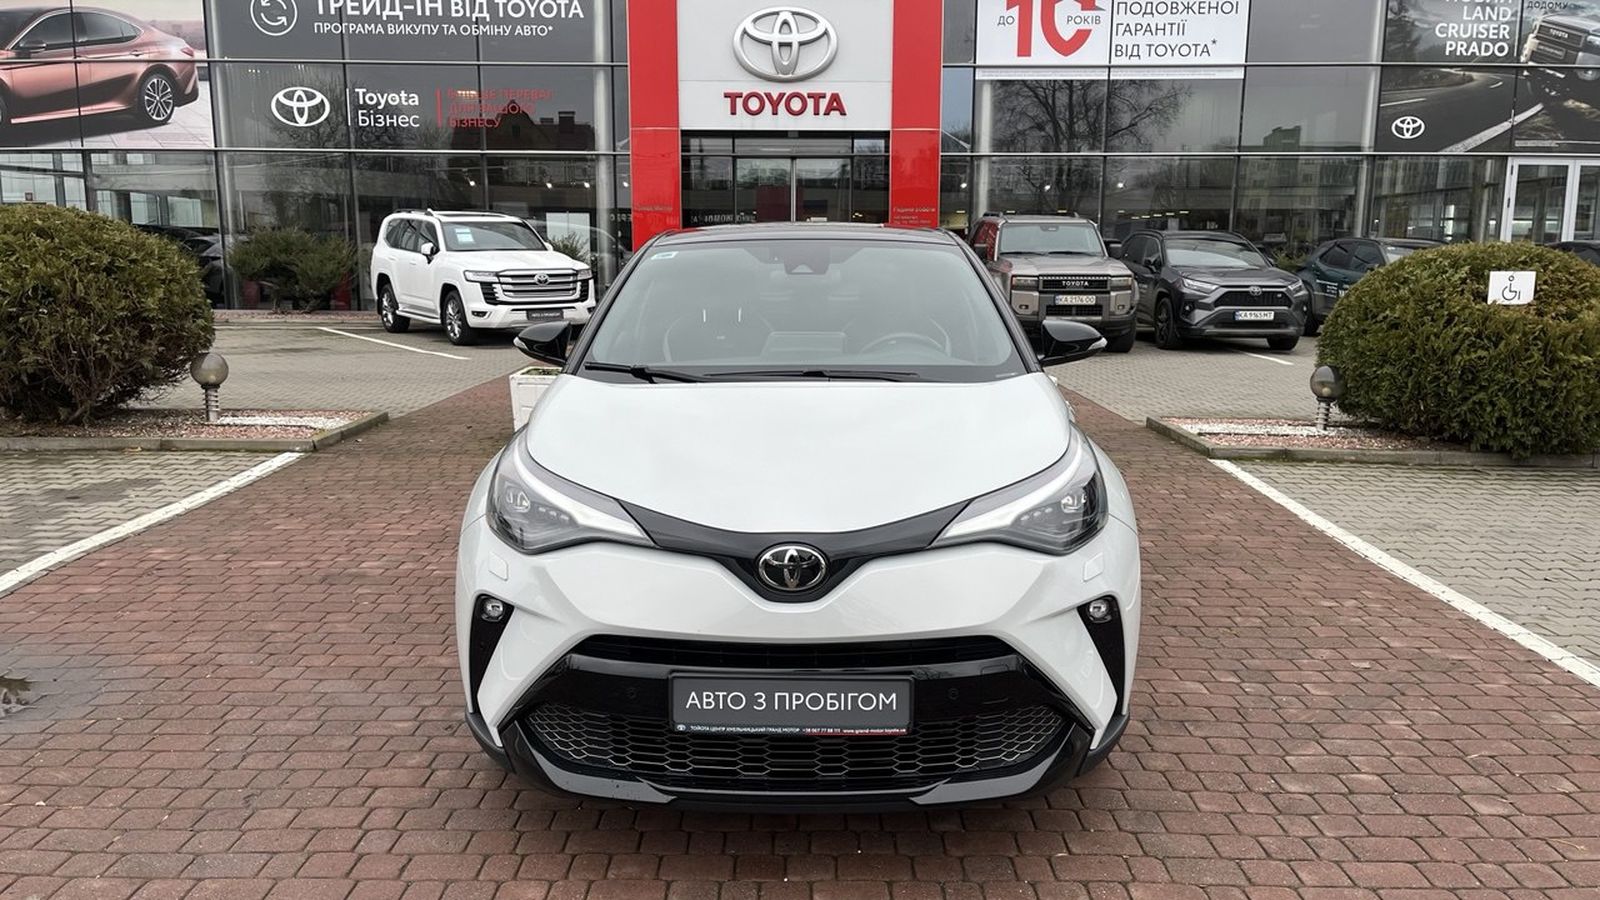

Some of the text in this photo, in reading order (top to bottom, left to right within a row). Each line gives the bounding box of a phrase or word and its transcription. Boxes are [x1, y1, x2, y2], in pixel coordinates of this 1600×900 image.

[451, 0, 490, 21] ВІД
[498, 0, 585, 18] TOYOTA
[1463, 6, 1511, 21] LAND
[1527, 1, 1568, 10] ДОДОМУ
[997, 15, 1015, 26] ДО
[1066, 15, 1102, 26] РОКІВ
[1115, 18, 1187, 37] ГАРАНТІЇ
[314, 22, 384, 36] ПРОГРАМА
[388, 23, 439, 36] ВИКУПУ
[442, 25, 457, 36] ТА
[460, 24, 512, 37] ОБМІНУ
[1435, 23, 1510, 39] CRUISER
[1115, 43, 1141, 60] ВІД
[1445, 41, 1509, 58] PRADO
[354, 88, 419, 109] Toyota
[724, 91, 847, 117] TOYOTA
[358, 110, 420, 128] Бізнес
[448, 117, 501, 128] БІЗНЕСУ
[685, 691, 897, 711] АВТО З ПРОБІГОМ
